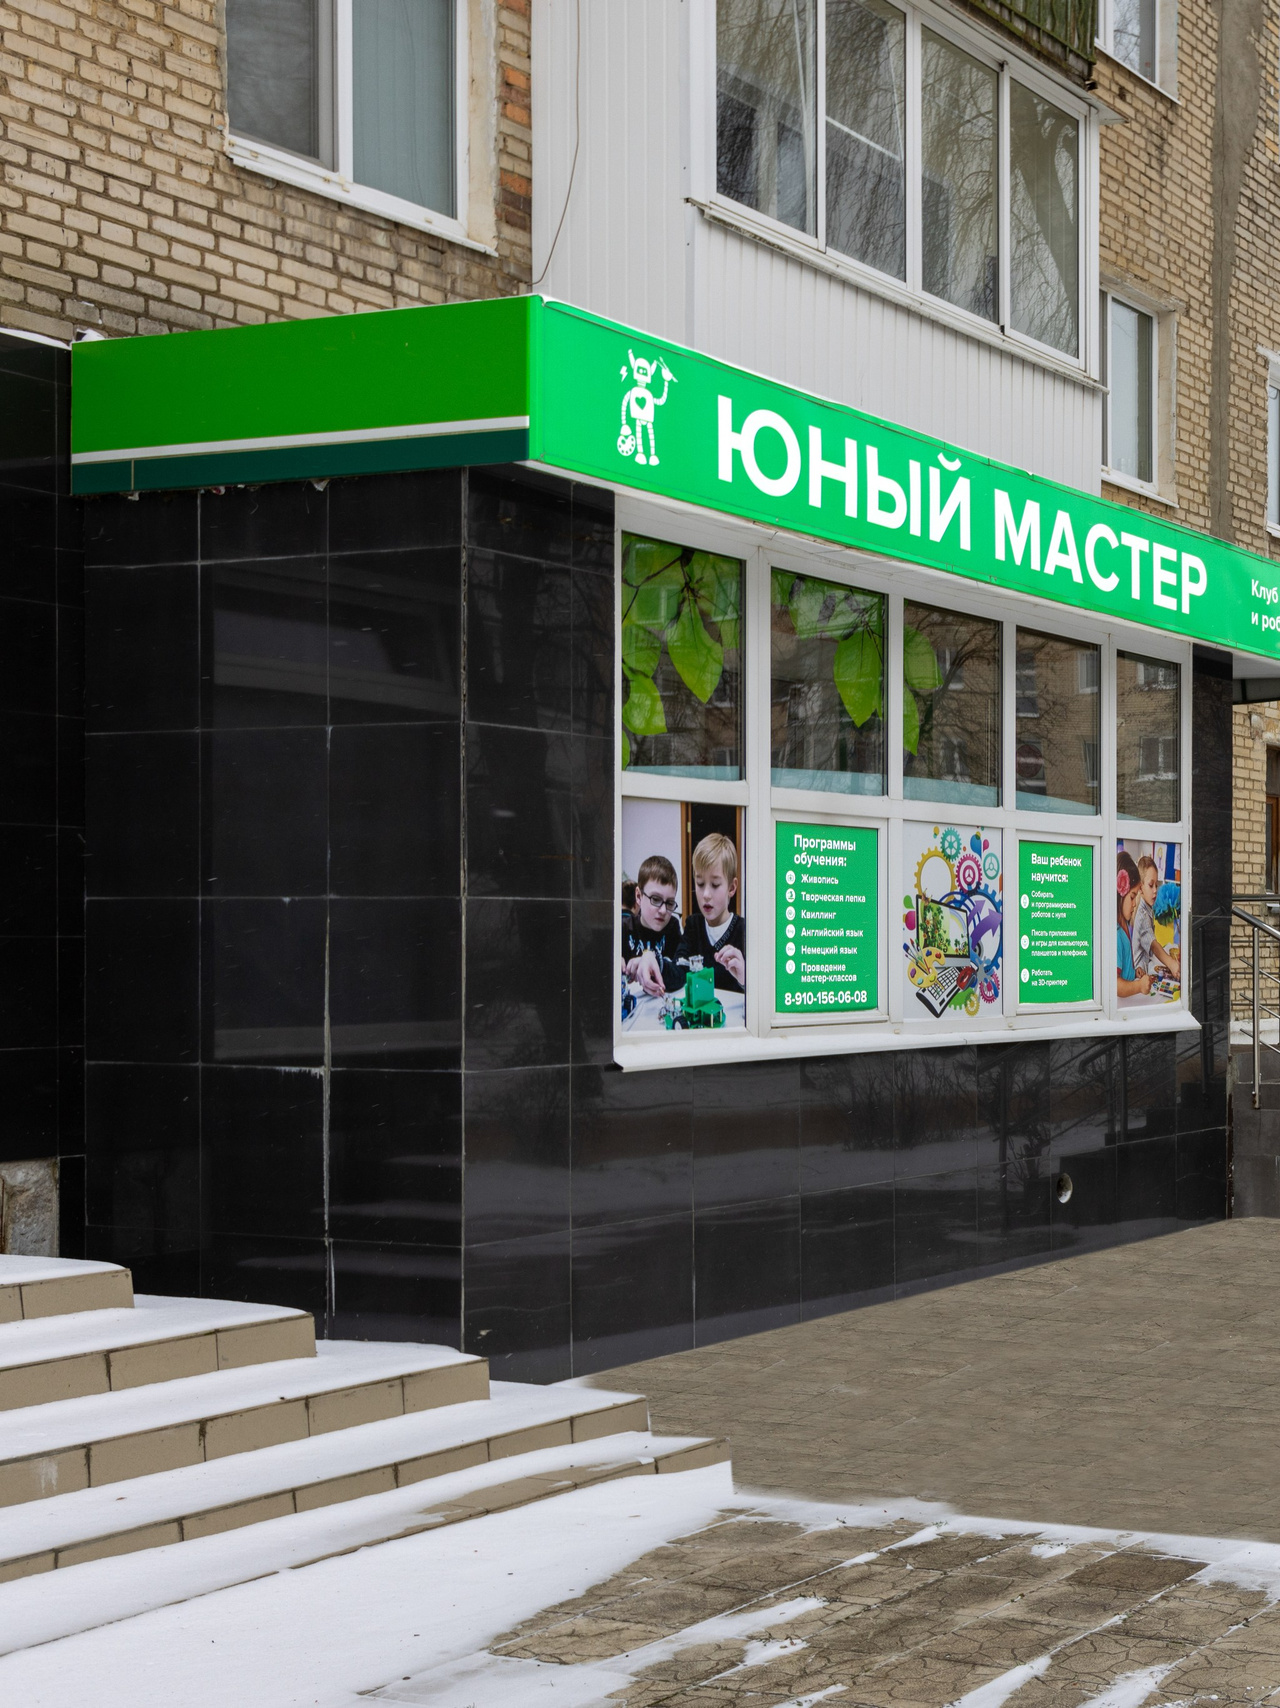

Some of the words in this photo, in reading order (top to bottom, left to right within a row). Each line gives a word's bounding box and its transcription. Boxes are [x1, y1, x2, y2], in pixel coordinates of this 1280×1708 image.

[717, 394, 972, 552] ЮНЫЙ
[994, 489, 1208, 616] МАСТЕР
[1251, 579, 1279, 605] Клуб
[1251, 611, 1259, 626] и
[793, 834, 857, 852] Программы
[793, 852, 848, 868] обучения:
[1031, 853, 1049, 865] Ваш
[1050, 855, 1082, 868] ребенок
[801, 874, 839, 885] Живопись
[1031, 872, 1069, 884] научится:
[801, 891, 844, 903] Творческая
[845, 895, 866, 903] лепка
[1031, 890, 1054, 899] Собирать
[1035, 902, 1077, 910] программировать
[801, 909, 837, 920] Квиллинг
[1031, 911, 1051, 919] роботов
[801, 927, 844, 938] Английский
[845, 929, 864, 938] язык
[1031, 929, 1048, 937] Писать
[801, 945, 838, 956] Немецкий
[839, 947, 858, 955] язык
[801, 963, 846, 974] Проведение
[1031, 969, 1053, 977] Работать
[801, 974, 857, 984] мастер-классов
[784, 990, 868, 1006] 8-910-156-06-08
